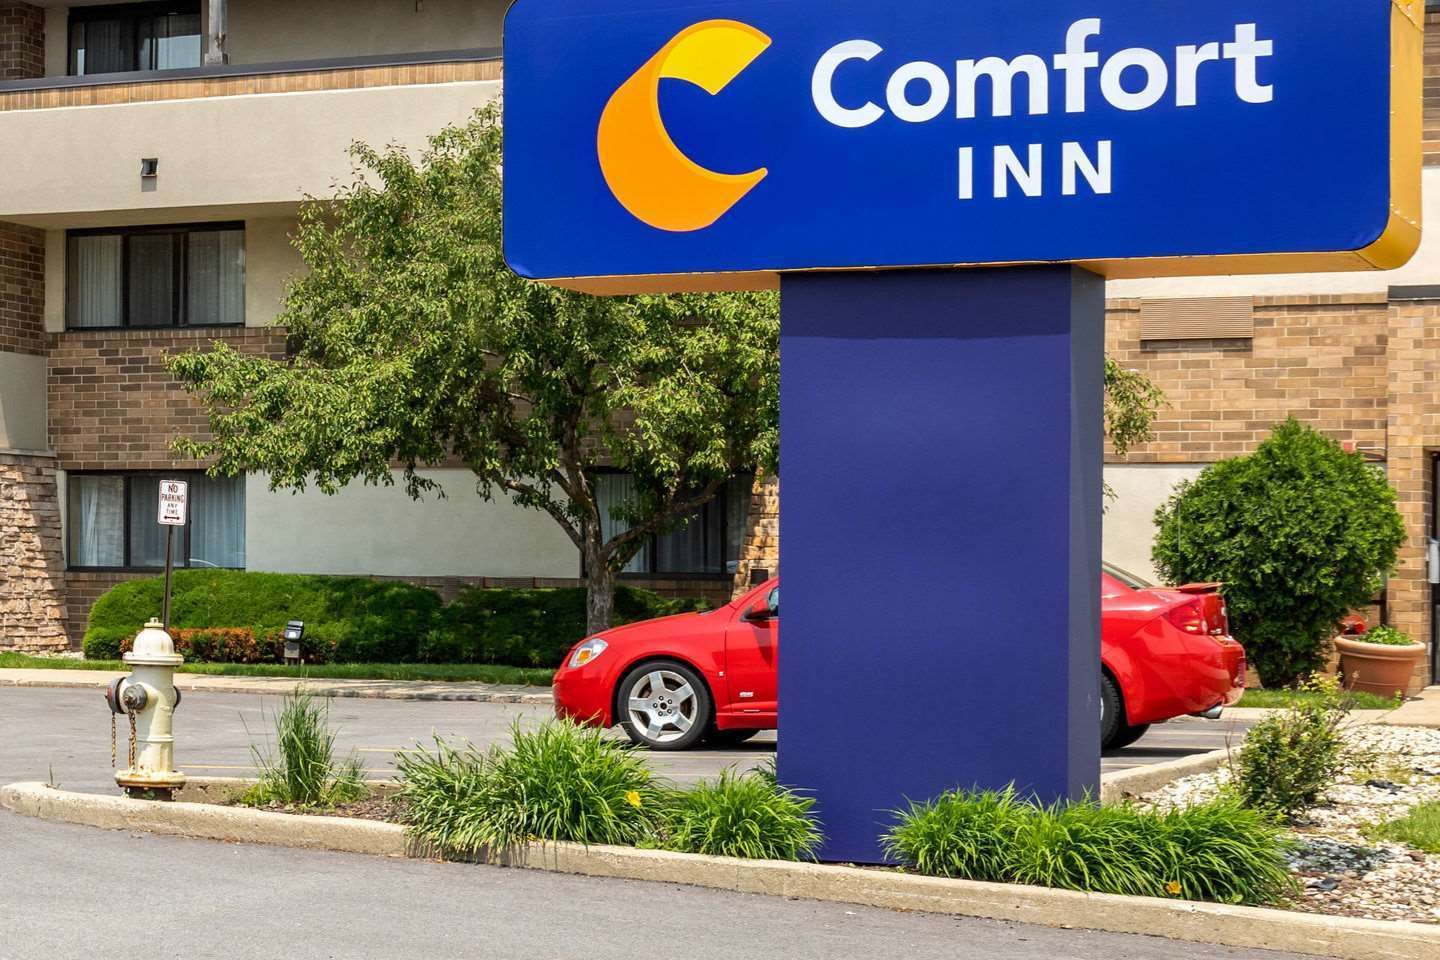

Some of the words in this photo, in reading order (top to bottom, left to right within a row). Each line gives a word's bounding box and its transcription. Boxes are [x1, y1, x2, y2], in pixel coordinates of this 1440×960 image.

[811, 17, 1274, 128] Comfort
[958, 140, 1112, 200] INN
[161, 494, 184, 503] PARKING
[168, 484, 178, 493] NO
